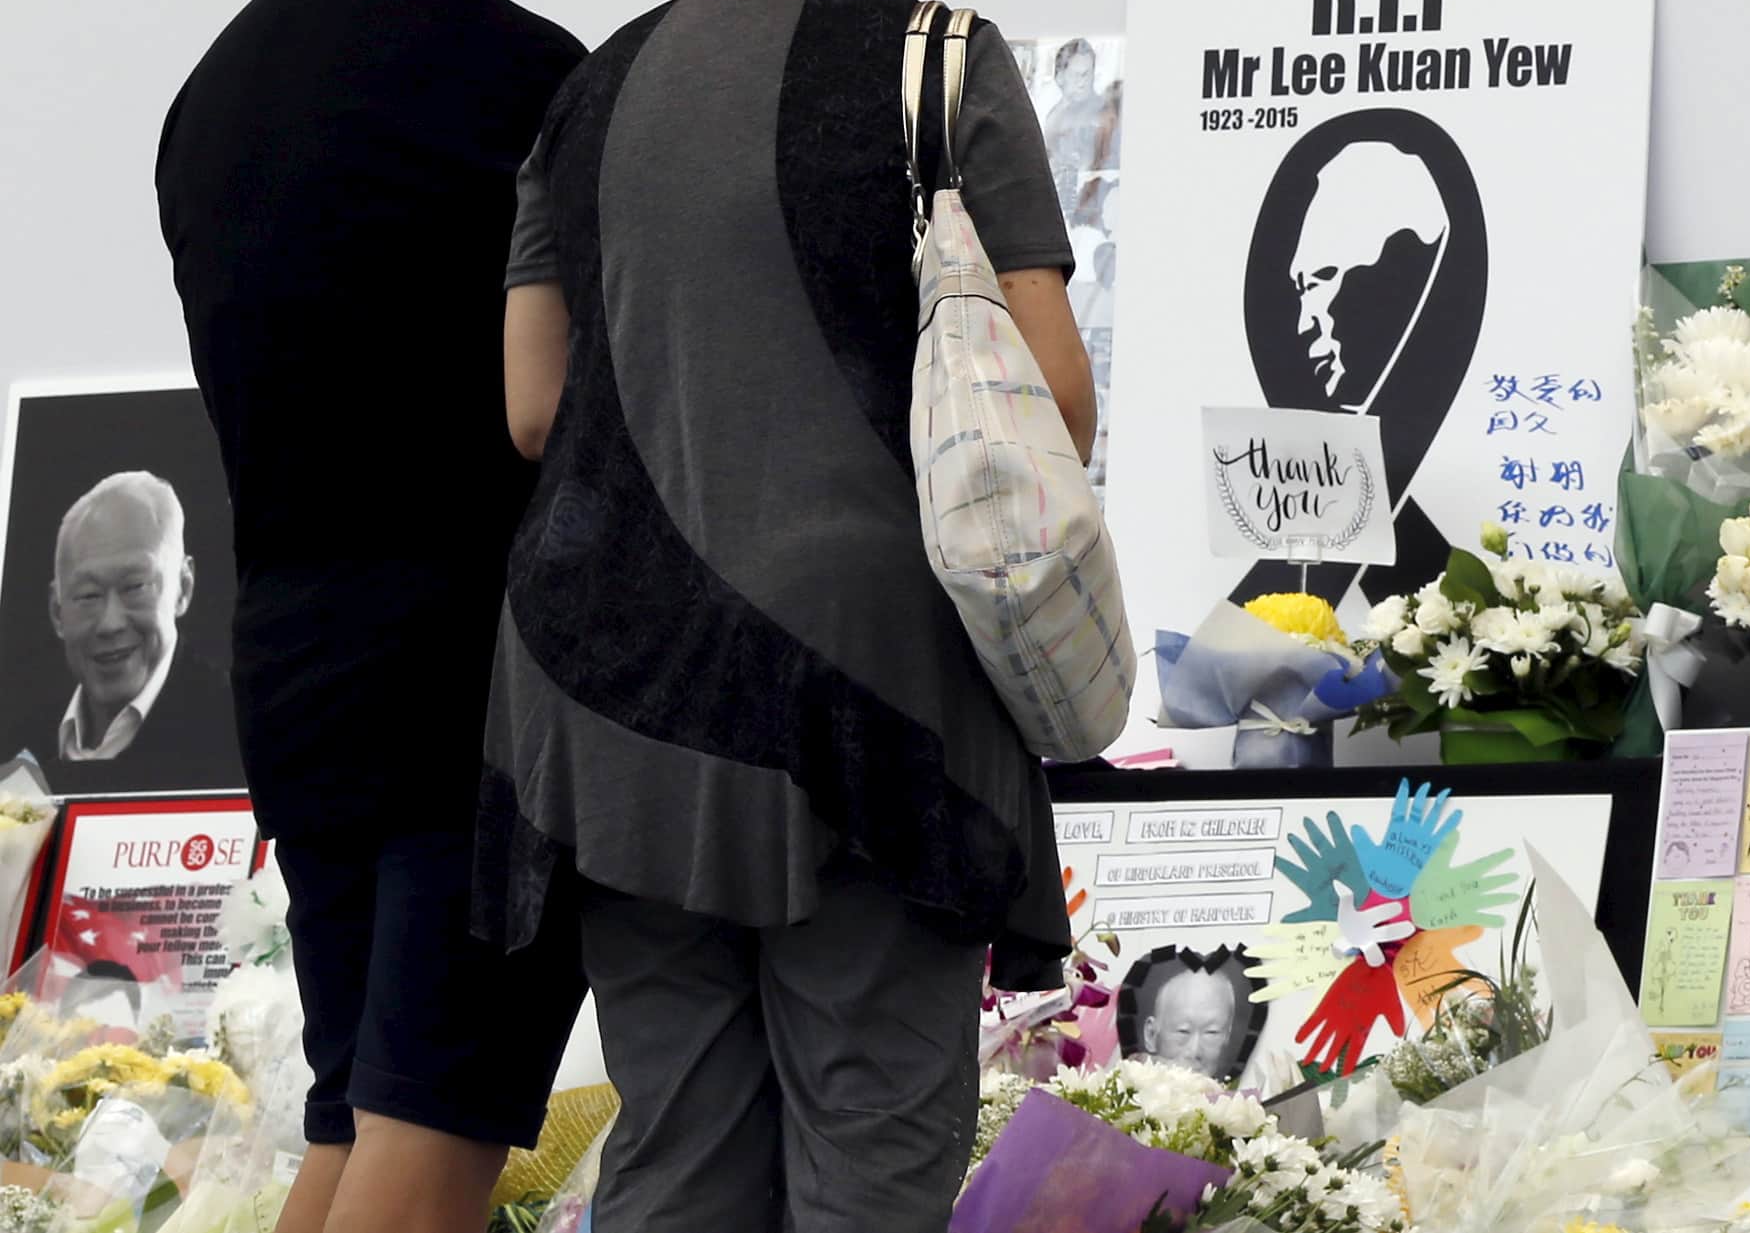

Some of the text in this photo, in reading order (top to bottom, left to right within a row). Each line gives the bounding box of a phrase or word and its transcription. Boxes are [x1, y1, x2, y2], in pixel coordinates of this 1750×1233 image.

[1201, 39, 1573, 99] Mr Lee Kuan Yew
[1200, 110, 1243, 131] 1923
[1213, 438, 1352, 487] thank
[1252, 483, 1339, 532] you
